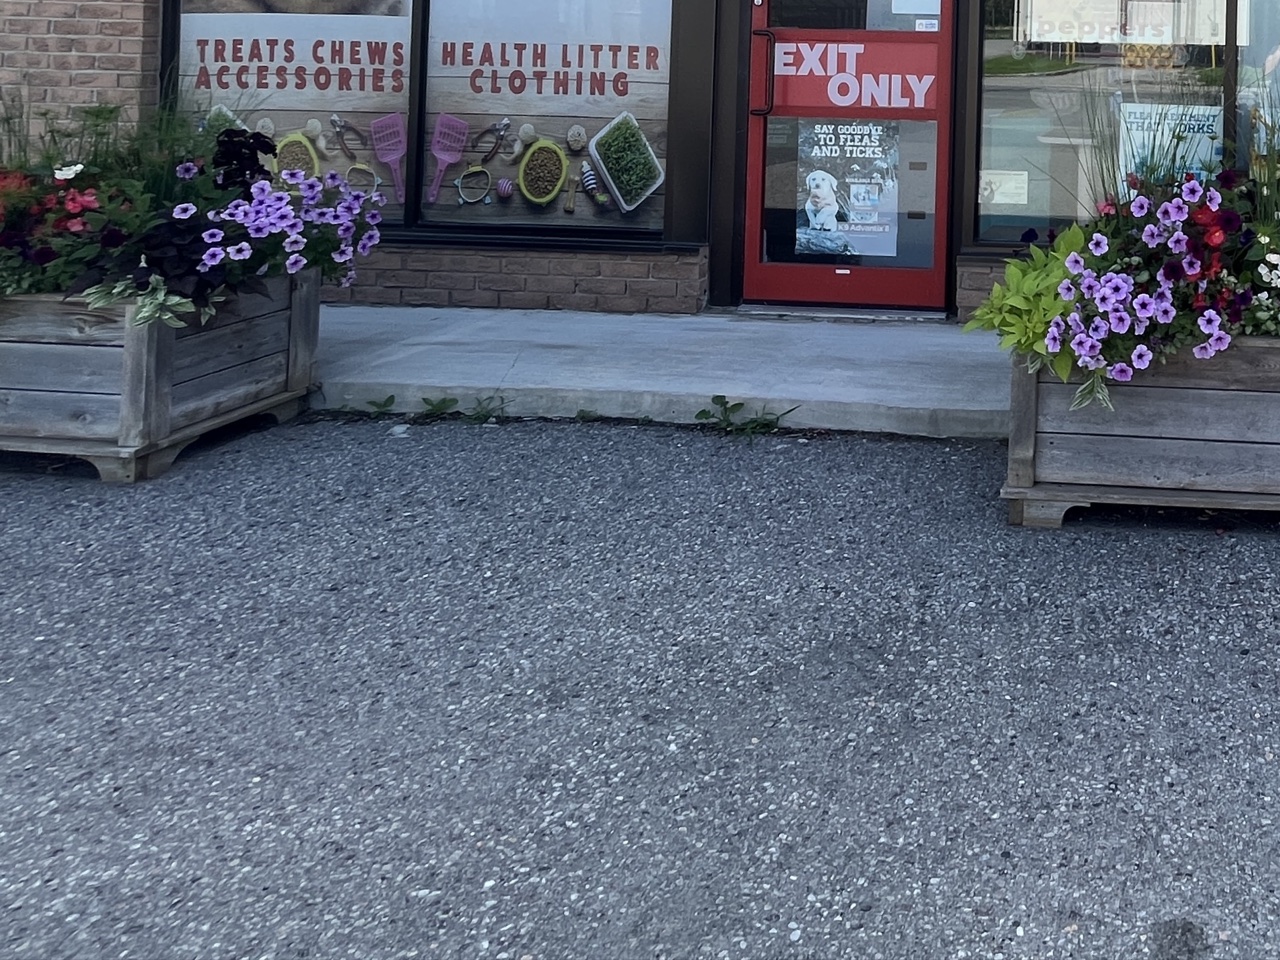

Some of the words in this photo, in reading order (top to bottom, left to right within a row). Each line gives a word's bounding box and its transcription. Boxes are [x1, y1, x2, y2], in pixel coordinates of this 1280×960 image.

[1037, 19, 1165, 40] peppers
[196, 40, 296, 65] TREATS
[312, 40, 405, 67] CHEWS
[442, 41, 547, 68] HEALTH
[562, 44, 660, 71] LITTER
[774, 43, 865, 76] EXIT
[194, 66, 405, 94] ACCESSORIES
[469, 69, 630, 97] CLOTHING
[827, 72, 936, 108] ONLY
[1128, 111, 1153, 120] FLEA
[815, 124, 834, 134] SAY
[838, 125, 883, 135] GOODBYE
[1128, 121, 1159, 132] THAT
[819, 134, 835, 145] TO
[839, 135, 879, 146] FLEAS
[811, 146, 840, 157] AND
[845, 147, 885, 158] TICKS.
[838, 224, 849, 232] K9
